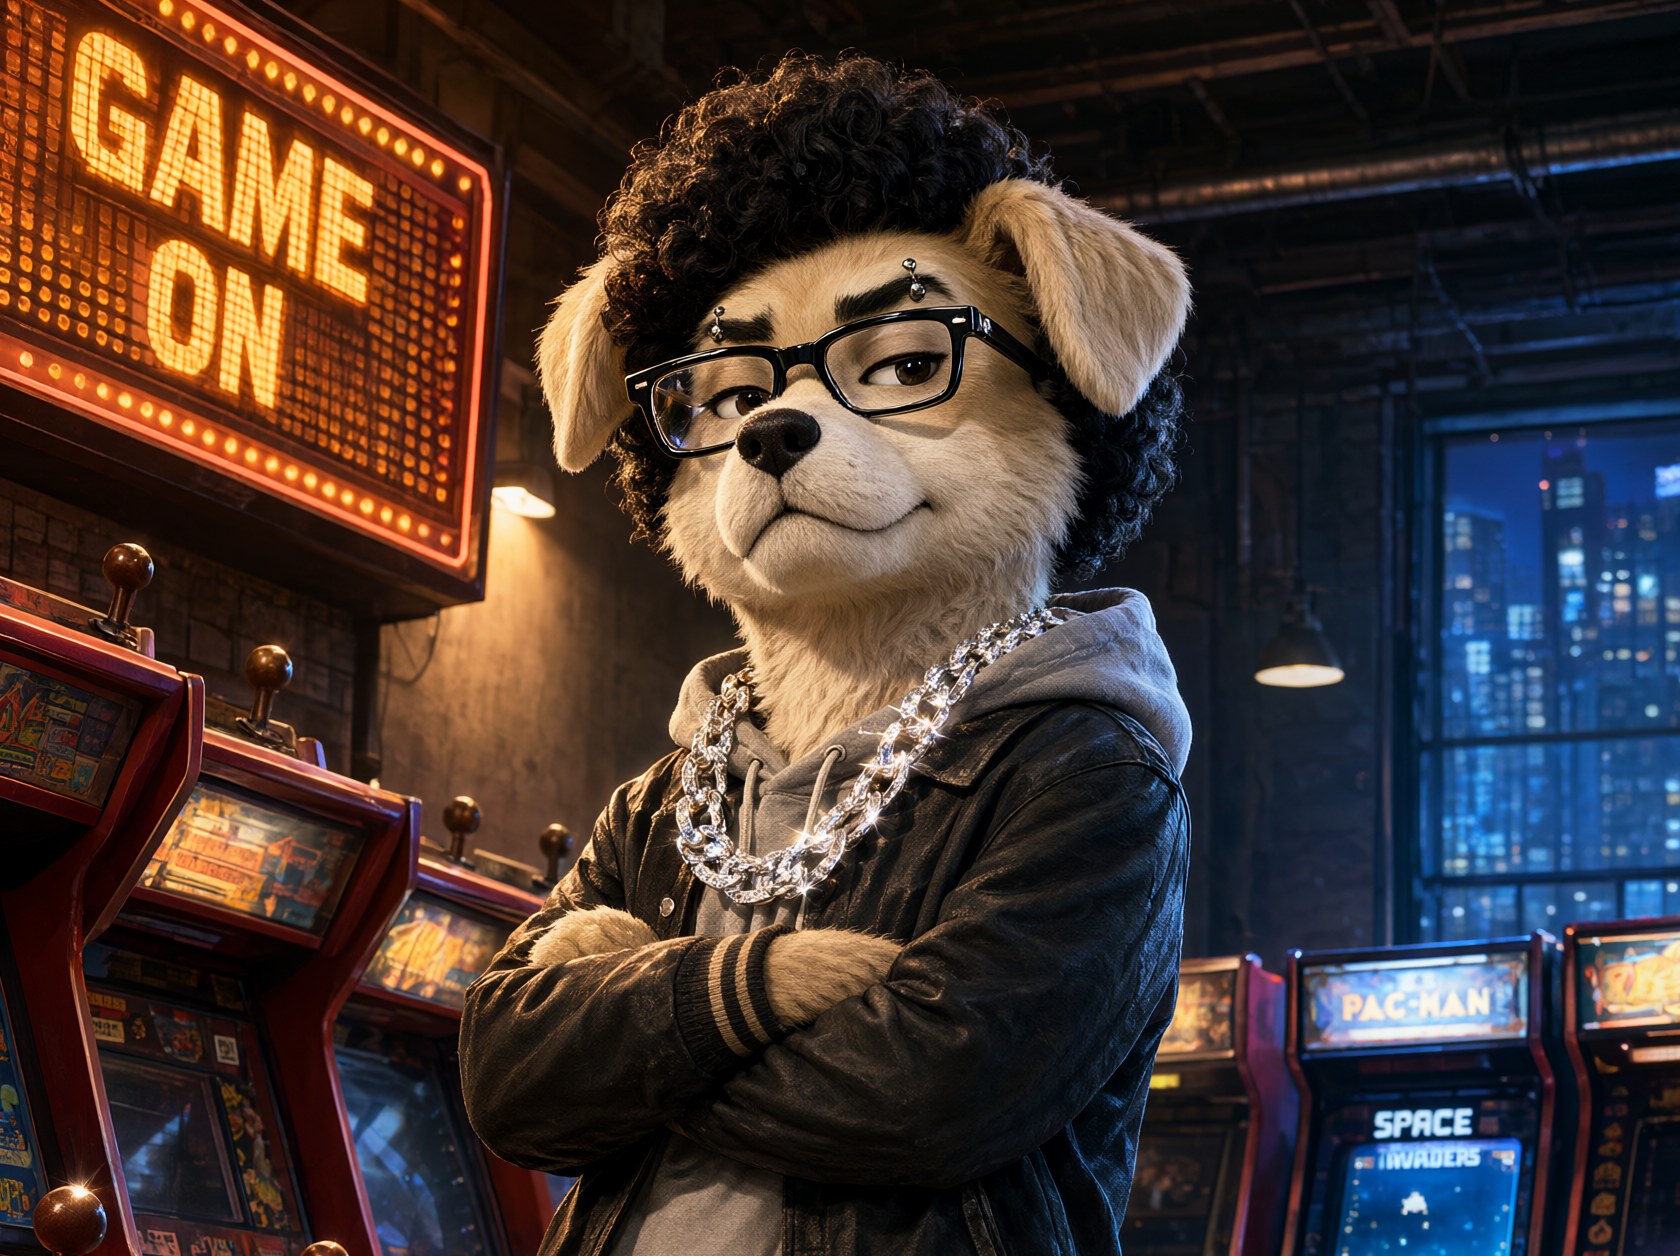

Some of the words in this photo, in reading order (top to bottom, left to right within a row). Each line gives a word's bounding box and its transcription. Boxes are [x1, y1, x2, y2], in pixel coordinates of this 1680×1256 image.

[70, 31, 374, 304] GAME
[147, 239, 284, 409] ON
[1373, 1107, 1474, 1139] SPACE
[1377, 1147, 1481, 1171] INVADERS
